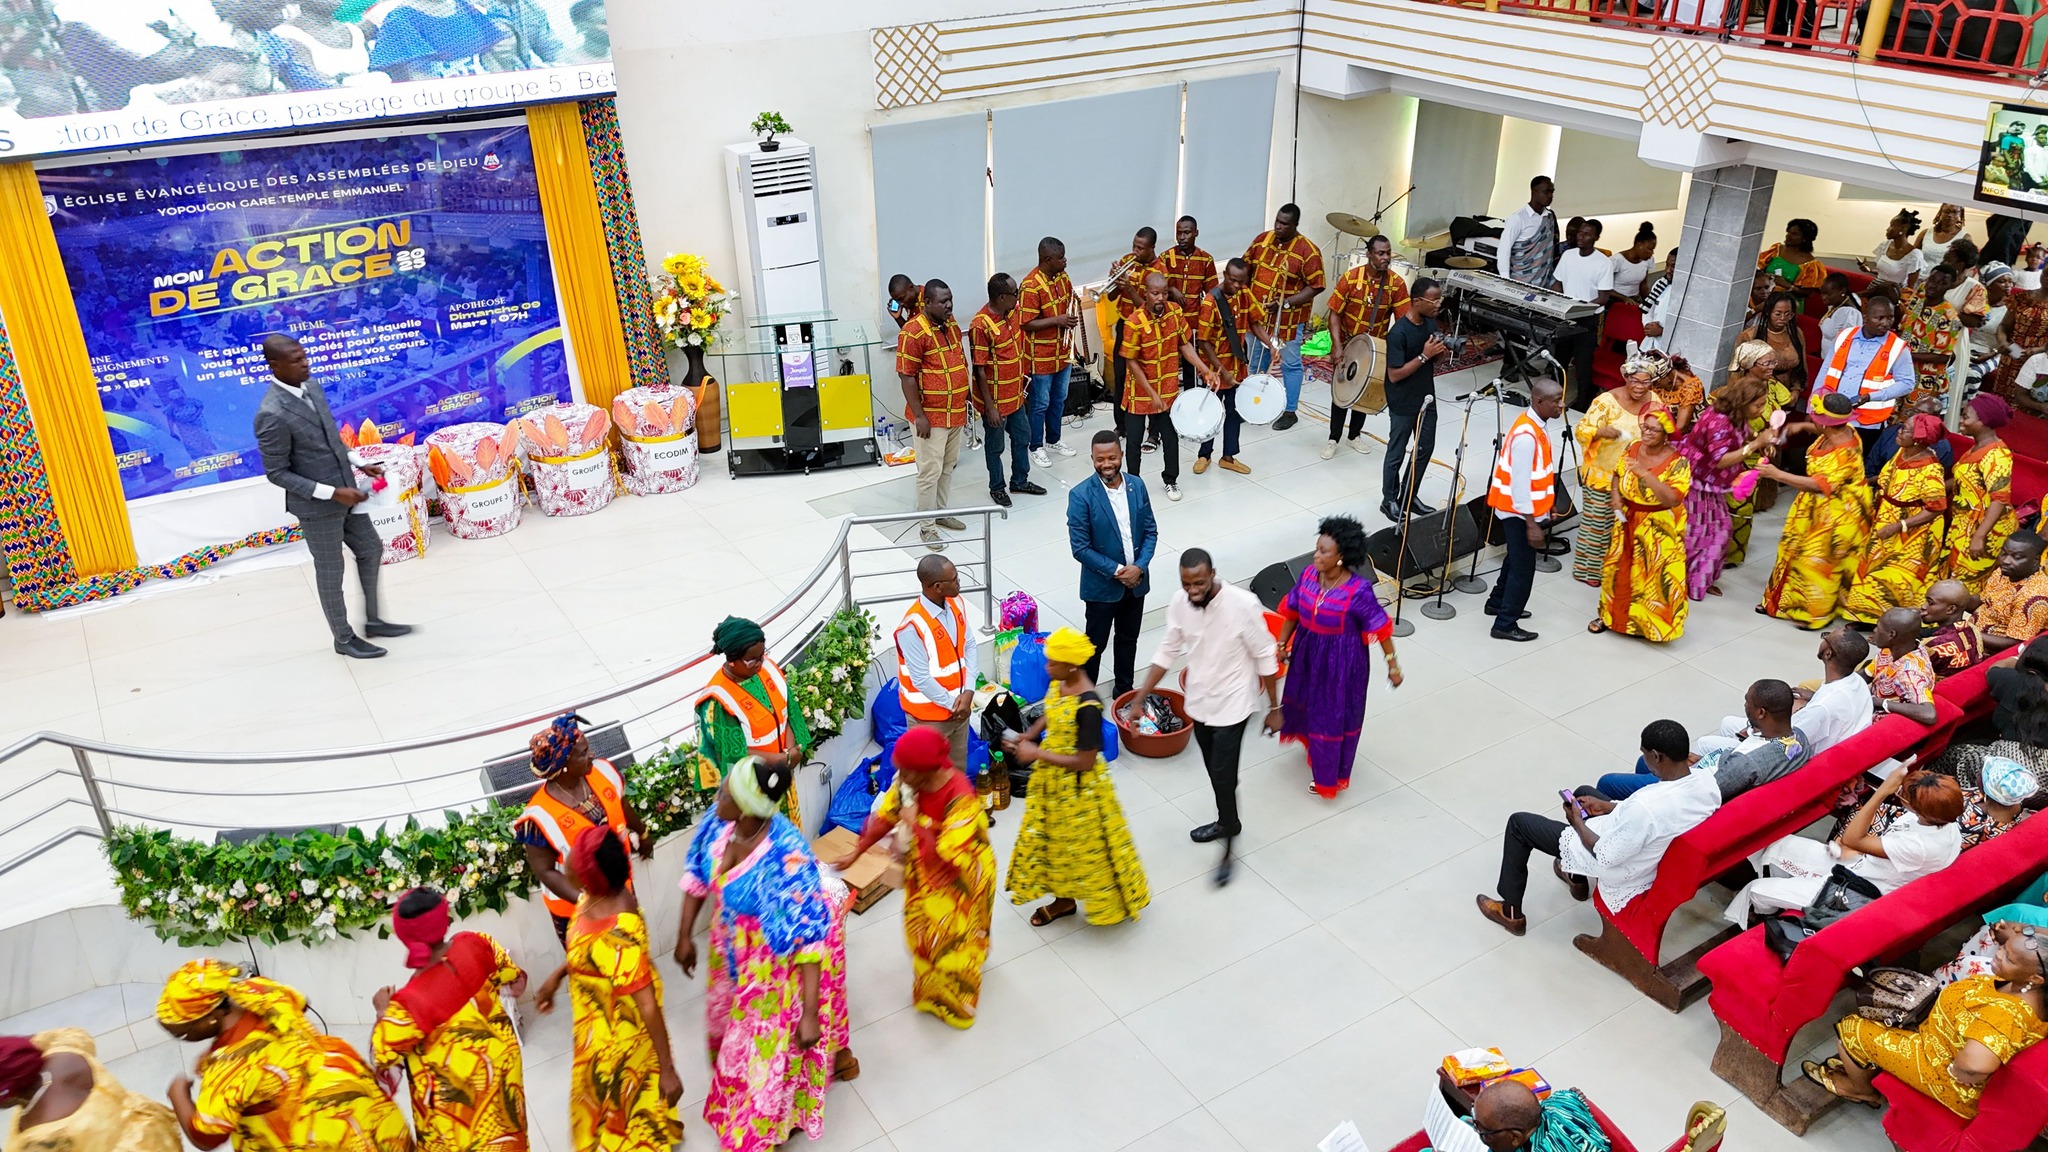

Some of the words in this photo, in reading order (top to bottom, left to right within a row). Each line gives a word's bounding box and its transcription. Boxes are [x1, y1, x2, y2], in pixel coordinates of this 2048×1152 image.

[132, 116, 168, 136] de
[288, 94, 402, 125] passage
[413, 88, 443, 107] du
[453, 81, 539, 108] groupe
[63, 192, 128, 208] ÉGLISE
[135, 178, 259, 200] ÉVANGÉLIQUE
[266, 174, 299, 187] DES
[305, 163, 410, 183] ASSEMBLÉES
[416, 161, 437, 172] DE
[443, 157, 479, 170] DIEU
[157, 200, 237, 217] YOPOUGON
[239, 196, 277, 208] GARE
[278, 191, 330, 204] TEMPLE
[333, 183, 404, 199] EMMANUEL
[153, 269, 204, 288] MON
[208, 219, 411, 279] ACTION
[149, 281, 221, 317] DE
[231, 252, 394, 301] GRACE
[449, 305, 519, 321] Dimanche
[450, 319, 488, 330] Mars
[498, 311, 529, 322] 07H
[222, 345, 249, 357] que
[251, 343, 264, 352] la
[298, 335, 316, 344] de
[362, 326, 370, 335] à
[373, 319, 422, 334] laquelle
[200, 358, 233, 370] vous
[236, 354, 266, 365] avez
[346, 336, 376, 349] pour
[378, 329, 420, 342] former
[91, 355, 170, 373] SEIGNEMENTS
[196, 372, 215, 382] un
[218, 366, 246, 378] seul
[249, 363, 270, 373] cor
[331, 350, 363, 360] dans
[365, 345, 386, 354] vos
[240, 376, 256, 386] Et
[309, 353, 397, 374] connaissants."
[123, 377, 151, 389] 18H
[437, 391, 479, 406] ACTION
[189, 451, 239, 468] ACTION
[654, 447, 689, 460] ECODIM
[572, 464, 600, 476] GROUPE
[471, 496, 503, 509] GROUPE
[372, 516, 396, 526] OUPE
